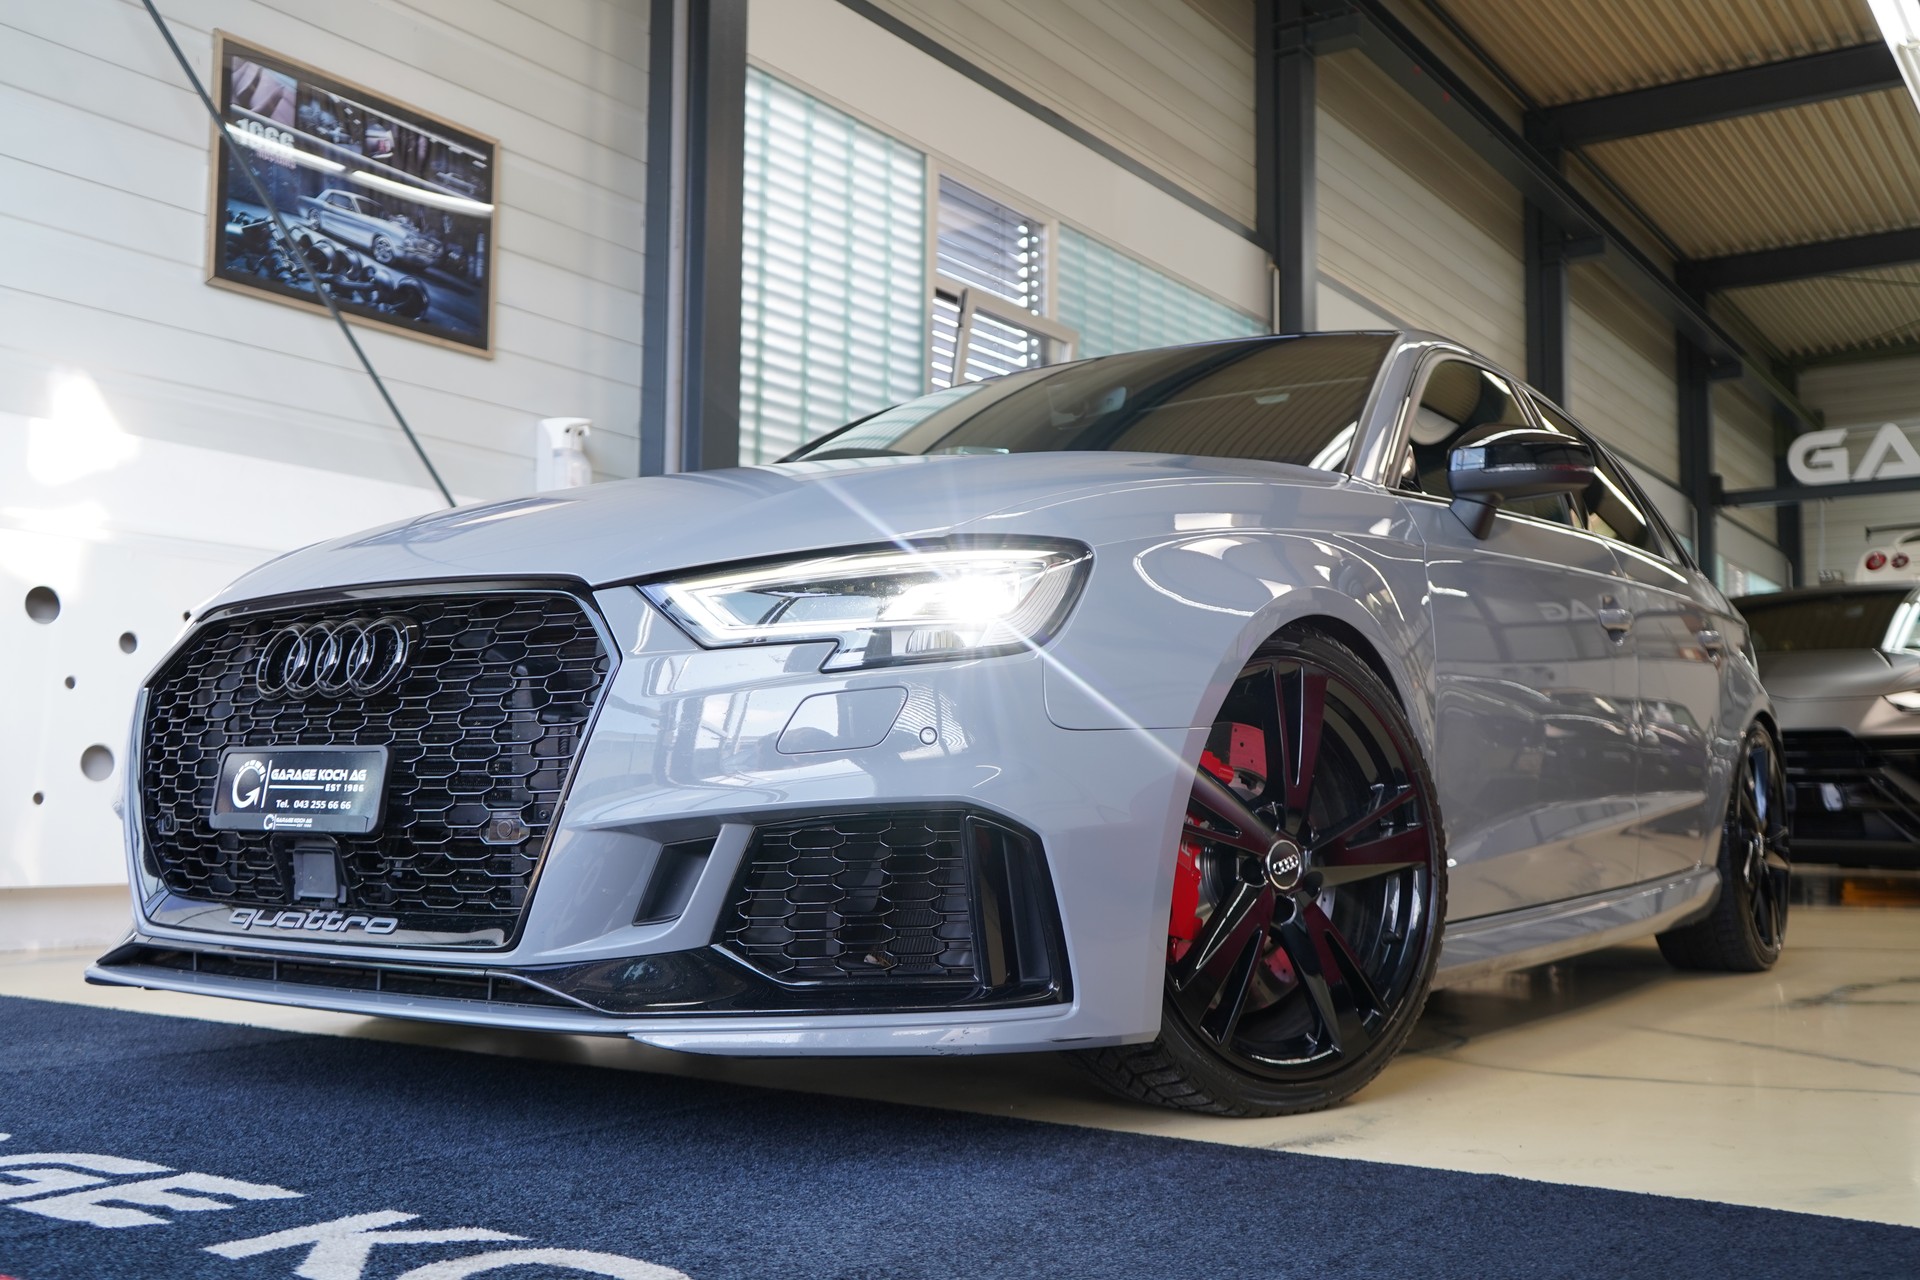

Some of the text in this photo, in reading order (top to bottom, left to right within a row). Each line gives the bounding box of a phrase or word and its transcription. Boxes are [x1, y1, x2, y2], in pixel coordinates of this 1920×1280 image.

[1787, 422, 1920, 486] GA
[270, 768, 368, 781] GARAGE KOCH AG
[324, 783, 365, 792] EST 1986
[275, 799, 352, 810] Tel. 043 255 66 66
[229, 907, 398, 934] quattro
[0, 1132, 306, 1229] GE
